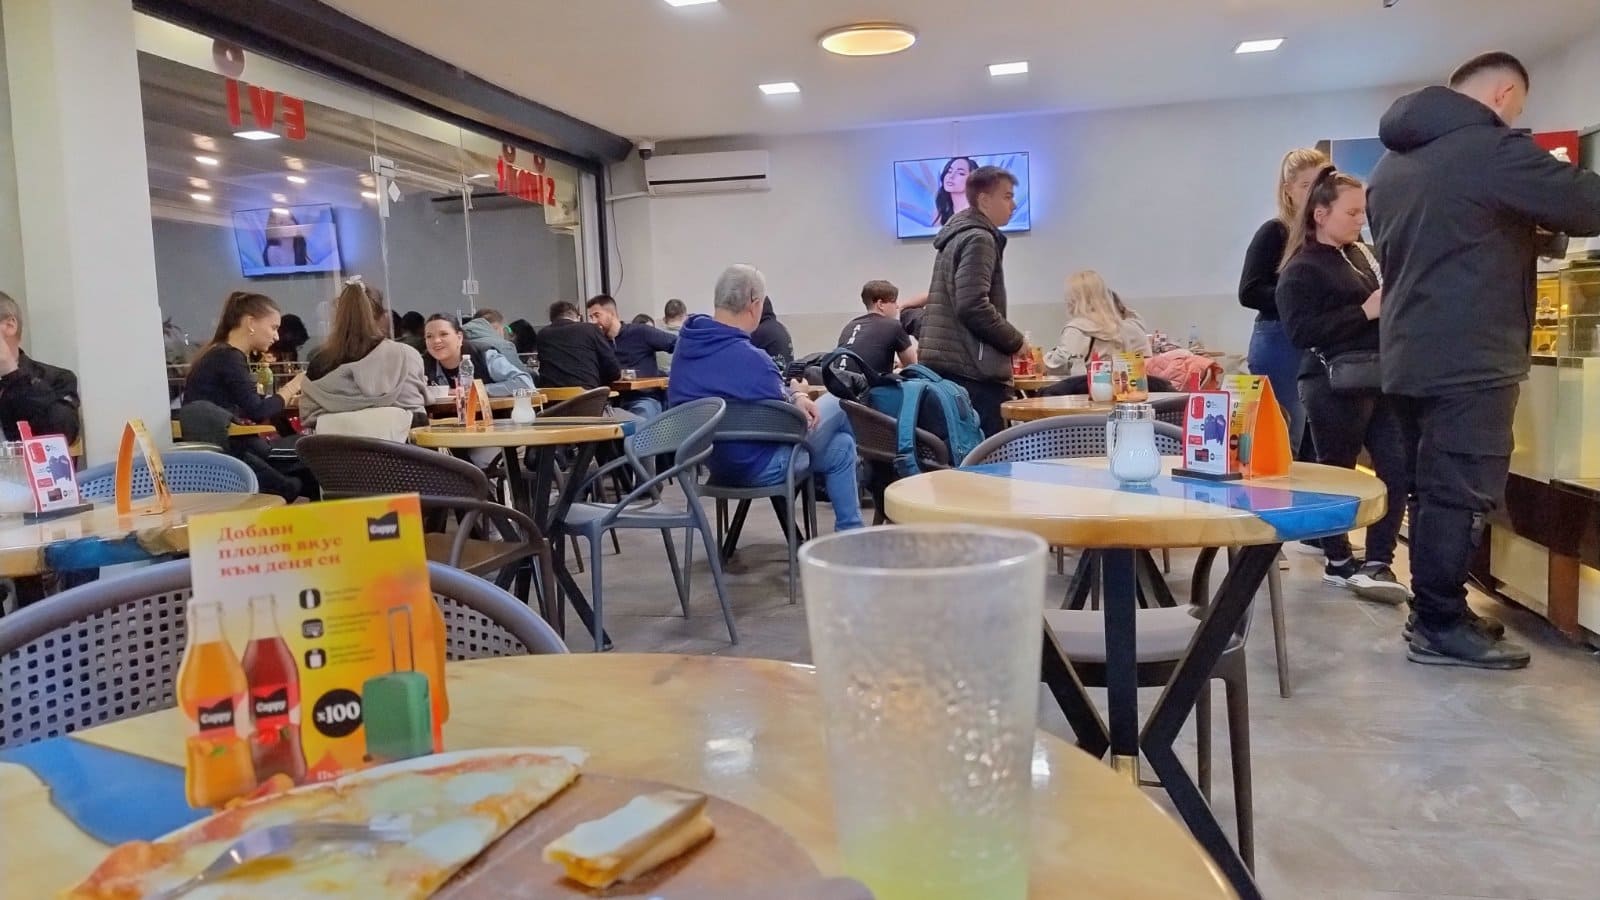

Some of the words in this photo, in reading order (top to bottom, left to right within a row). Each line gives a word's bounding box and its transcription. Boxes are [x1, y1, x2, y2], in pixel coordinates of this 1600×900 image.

[217, 523, 293, 543] Добави
[218, 541, 292, 560] плодов
[295, 536, 343, 551] вкус
[221, 564, 261, 577] към
[266, 556, 313, 574] деня
[318, 553, 341, 566] си
